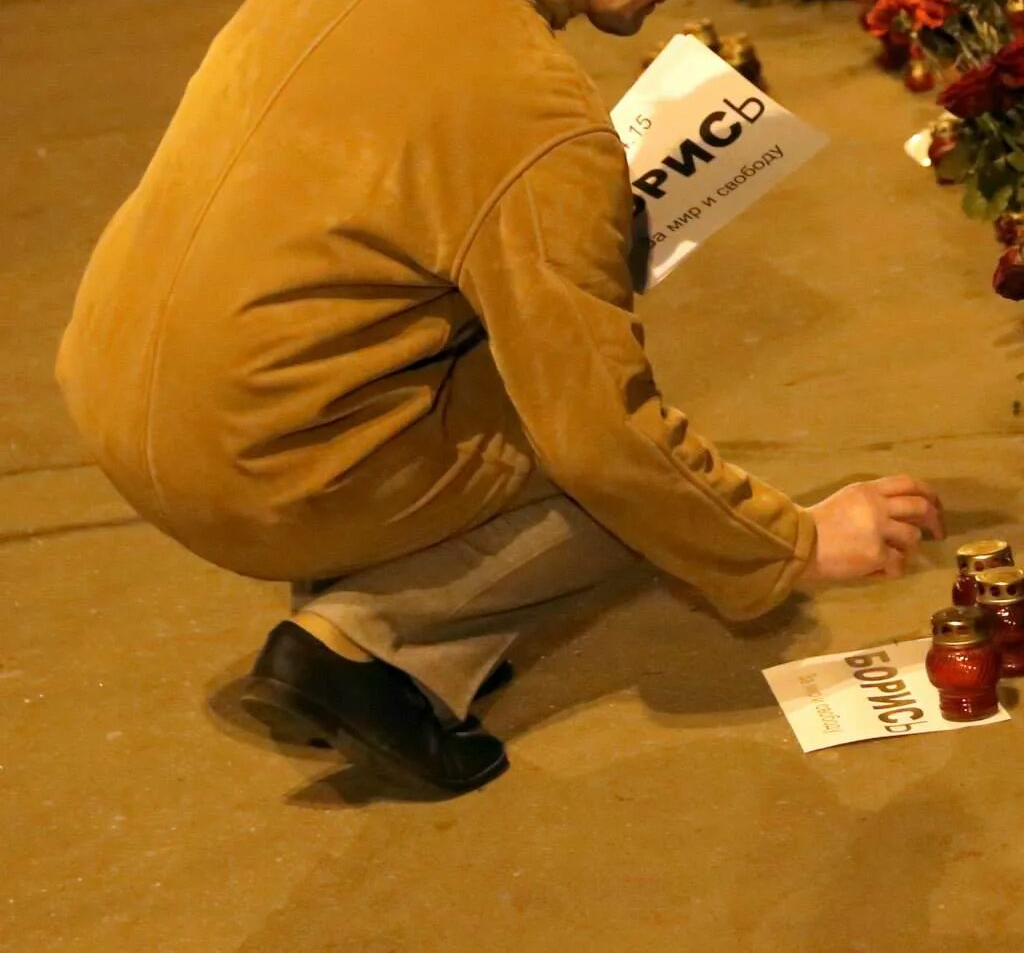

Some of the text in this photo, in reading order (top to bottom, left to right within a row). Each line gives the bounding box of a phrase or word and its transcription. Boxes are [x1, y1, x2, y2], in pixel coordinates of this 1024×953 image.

[666, 207, 702, 232] мир
[702, 196, 717, 207] и
[716, 144, 783, 197] свободу
[845, 650, 928, 734] БОРИСЬ
